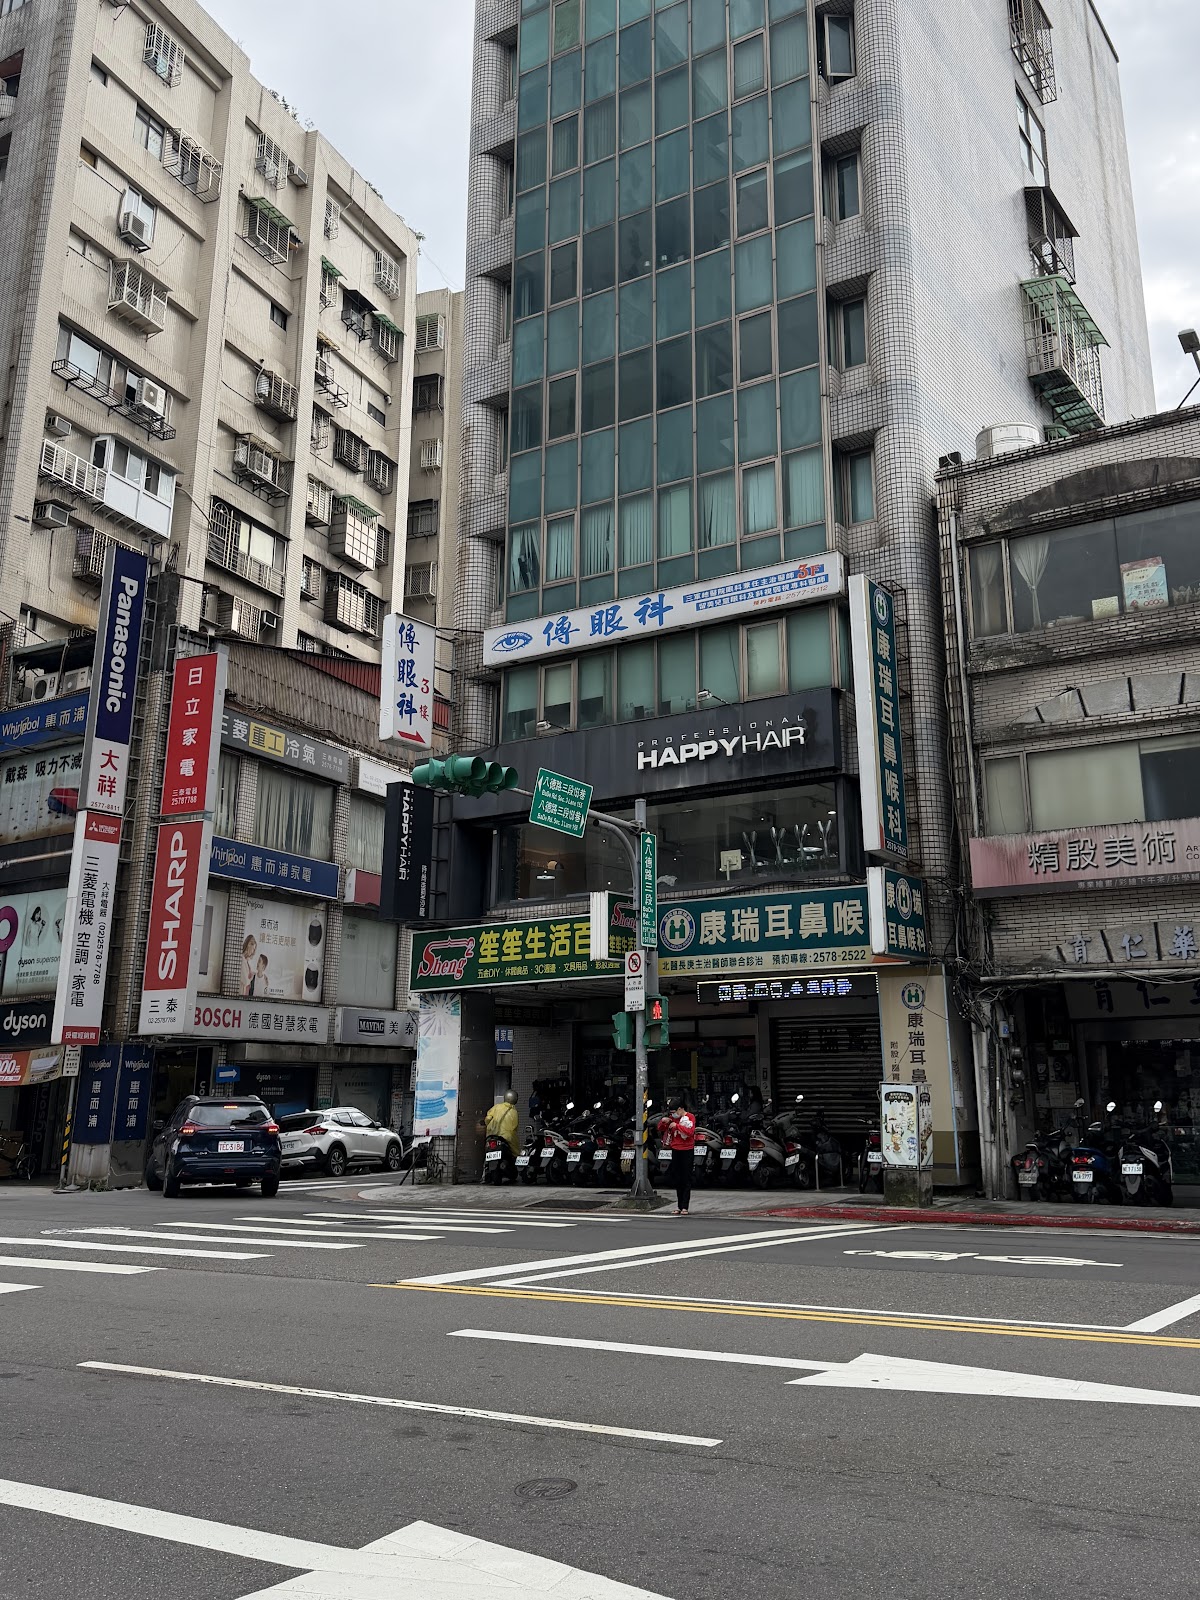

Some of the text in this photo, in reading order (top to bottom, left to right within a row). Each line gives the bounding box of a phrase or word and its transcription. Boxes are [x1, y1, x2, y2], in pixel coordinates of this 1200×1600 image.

[797, 563, 821, 579] 3F
[542, 593, 673, 646] 傅眼科
[106, 576, 138, 713] Panasonic
[397, 621, 419, 726] 傅眼科
[2, 716, 40, 738] Whirlpool
[179, 667, 202, 777] 日立家電
[637, 714, 804, 748] PROFESSIONAL
[876, 627, 902, 841] 康瑞耳鼻喉科
[5, 764, 28, 785] 戴森
[97, 750, 120, 797] 大祥
[250, 855, 312, 883] 惠而浦家電
[645, 844, 653, 906] 八德路三段
[78, 856, 99, 926] 三菱電機
[99, 882, 110, 917] 大祥電器
[158, 831, 188, 980] SHARP
[699, 899, 864, 946] 康瑞耳鼻喉
[887, 921, 926, 953] 耳鼻喉科
[478, 921, 590, 964] 笙笙生活百
[17, 956, 35, 968] dyson
[3, 1010, 46, 1036] dyson
[149, 998, 178, 1013] 三泰
[194, 1007, 319, 1034] BOSCH 德國智慧家電
[359, 1018, 385, 1033] MAYTAG
